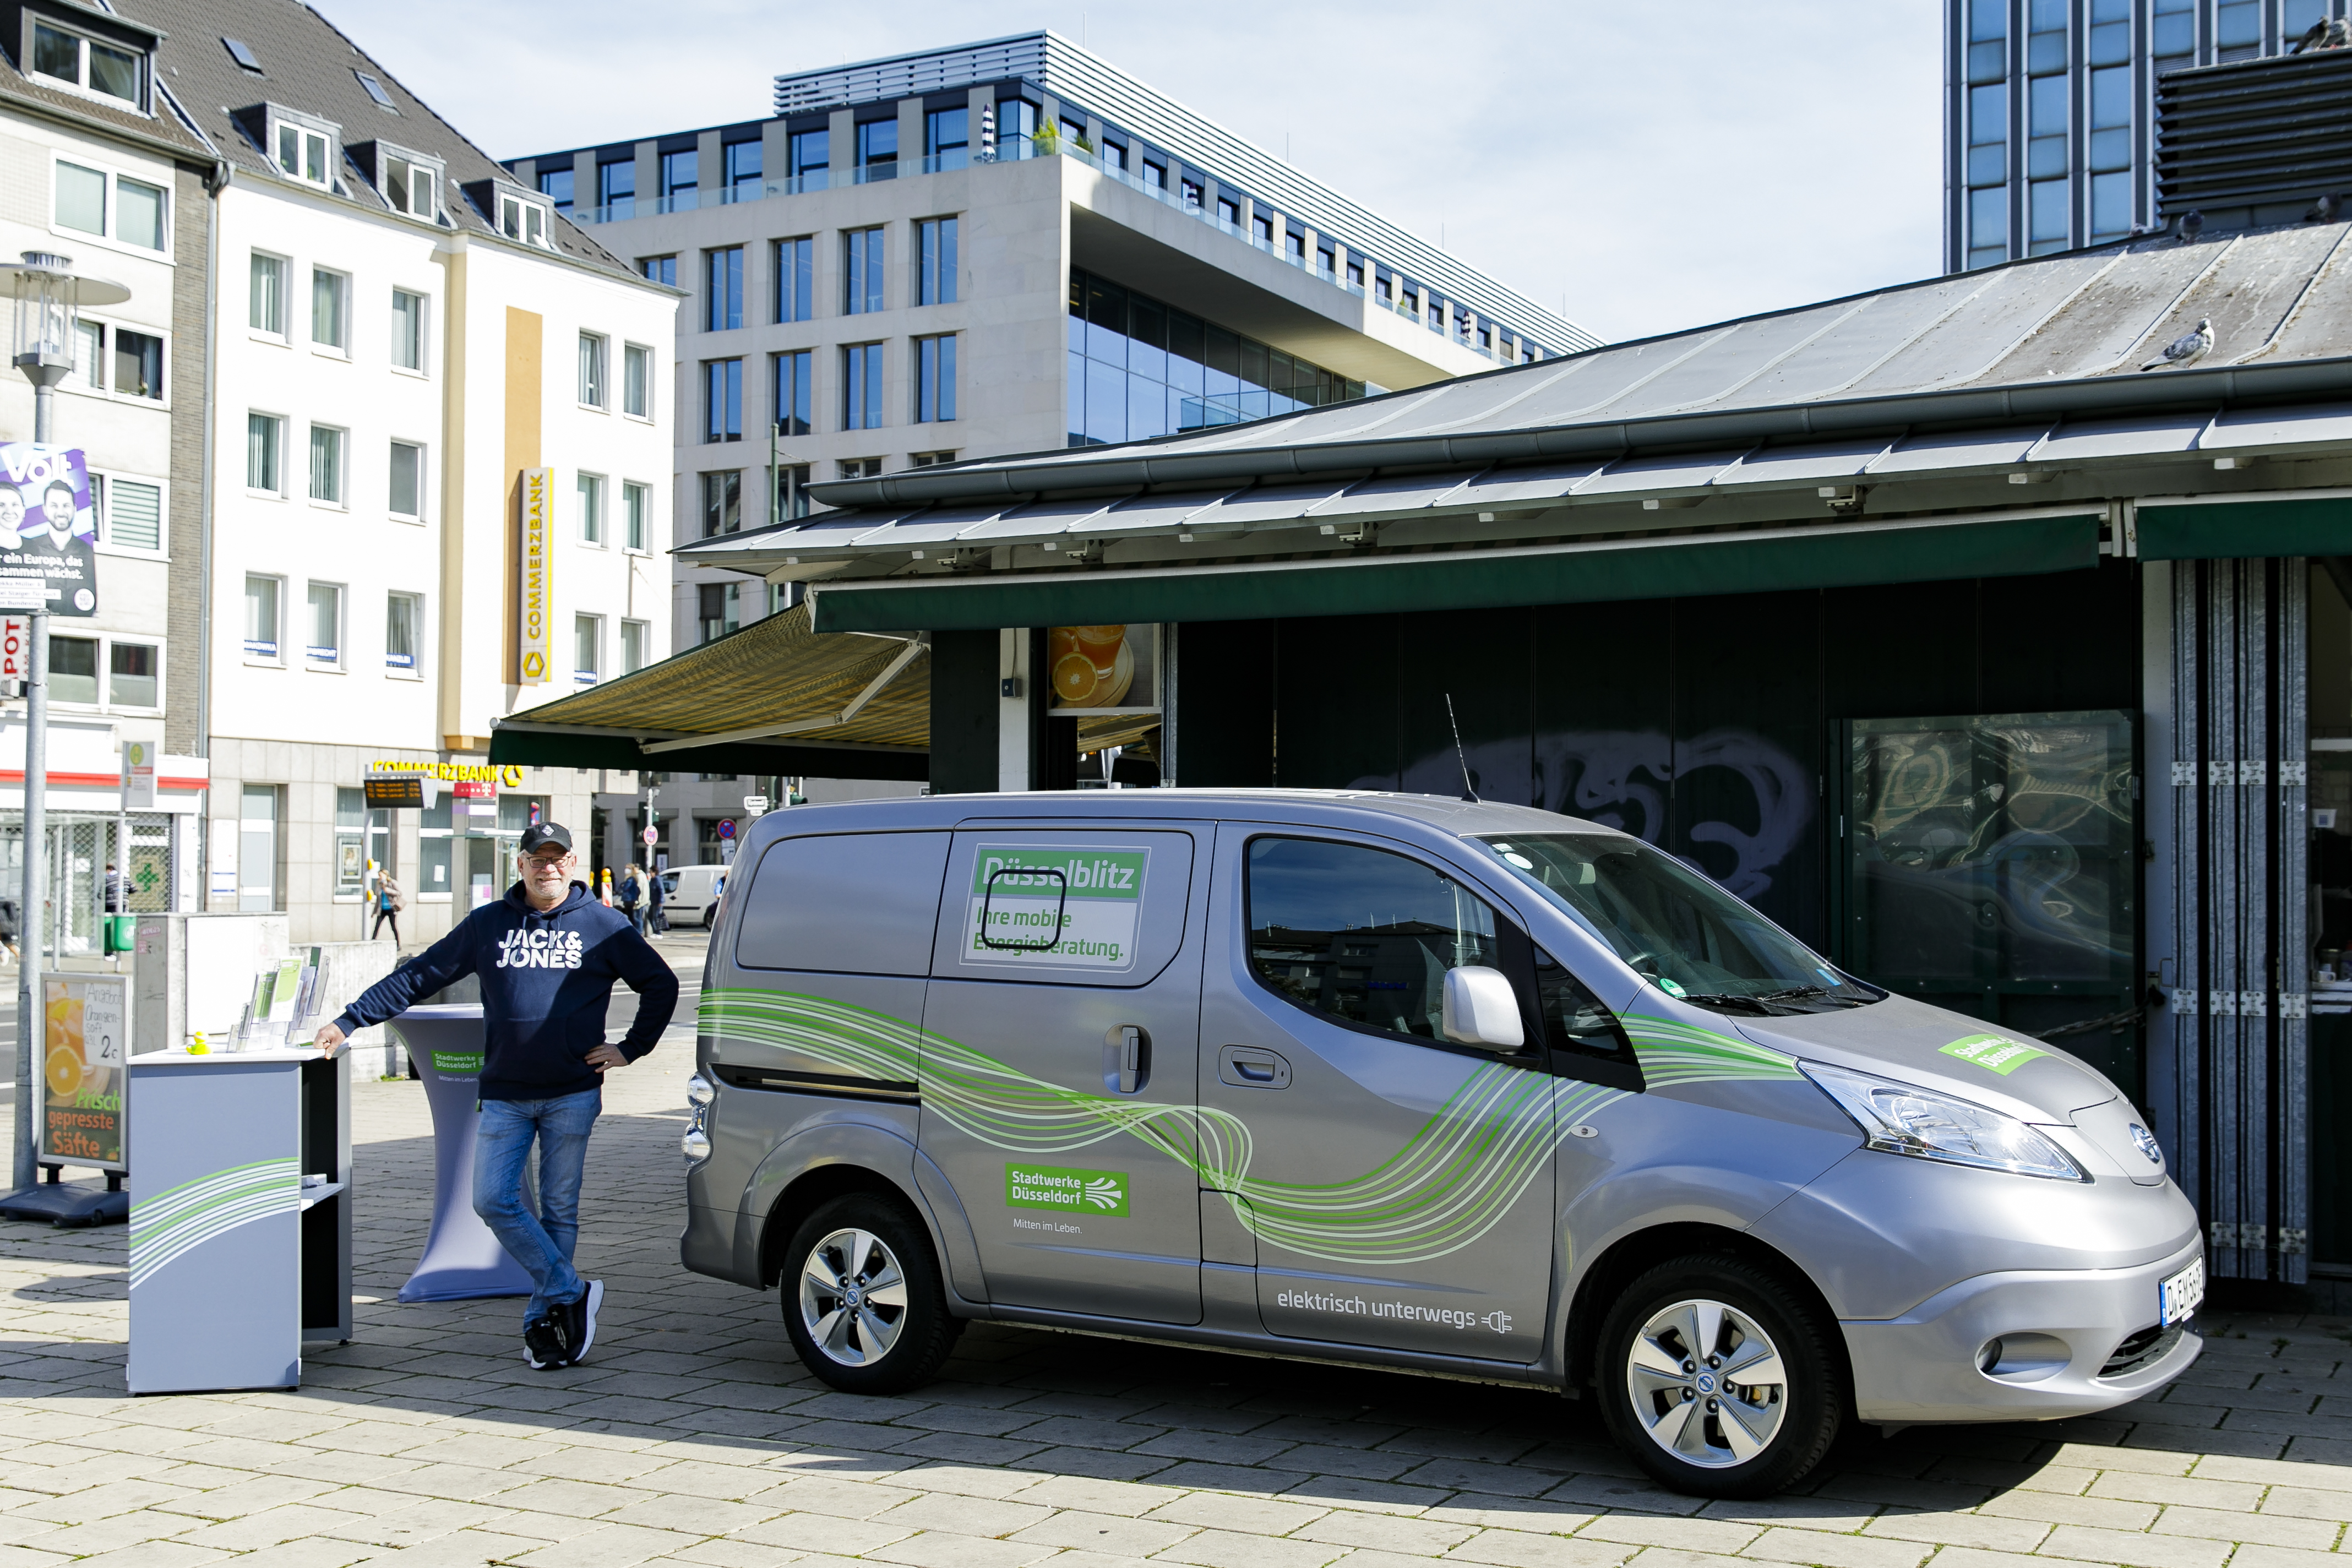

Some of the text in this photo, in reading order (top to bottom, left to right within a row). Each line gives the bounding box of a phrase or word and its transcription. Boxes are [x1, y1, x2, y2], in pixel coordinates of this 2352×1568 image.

[1, 449, 74, 487] Volt
[3, 552, 23, 564] ein
[24, 553, 66, 568] Europa,
[66, 555, 84, 567] das
[528, 473, 542, 640] COMMERZBANK
[45, 567, 84, 580] wächst.
[4, 619, 20, 679] POT
[373, 760, 499, 782] COMMERZBANK
[983, 857, 1135, 890] Düsselblitz
[977, 906, 1072, 928] Ihre mobie
[496, 948, 582, 969] JONES
[75, 1087, 122, 1112] Frisch
[48, 1111, 115, 1131] gepresste
[52, 1131, 100, 1158] Säfte
[1012, 1170, 1081, 1189] Stadtwerke
[1012, 1185, 1082, 1205] Düsseldorf
[1013, 1218, 1083, 1234] Mitten im Leben.
[1277, 1289, 1476, 1330] elektrisch unterwegs
